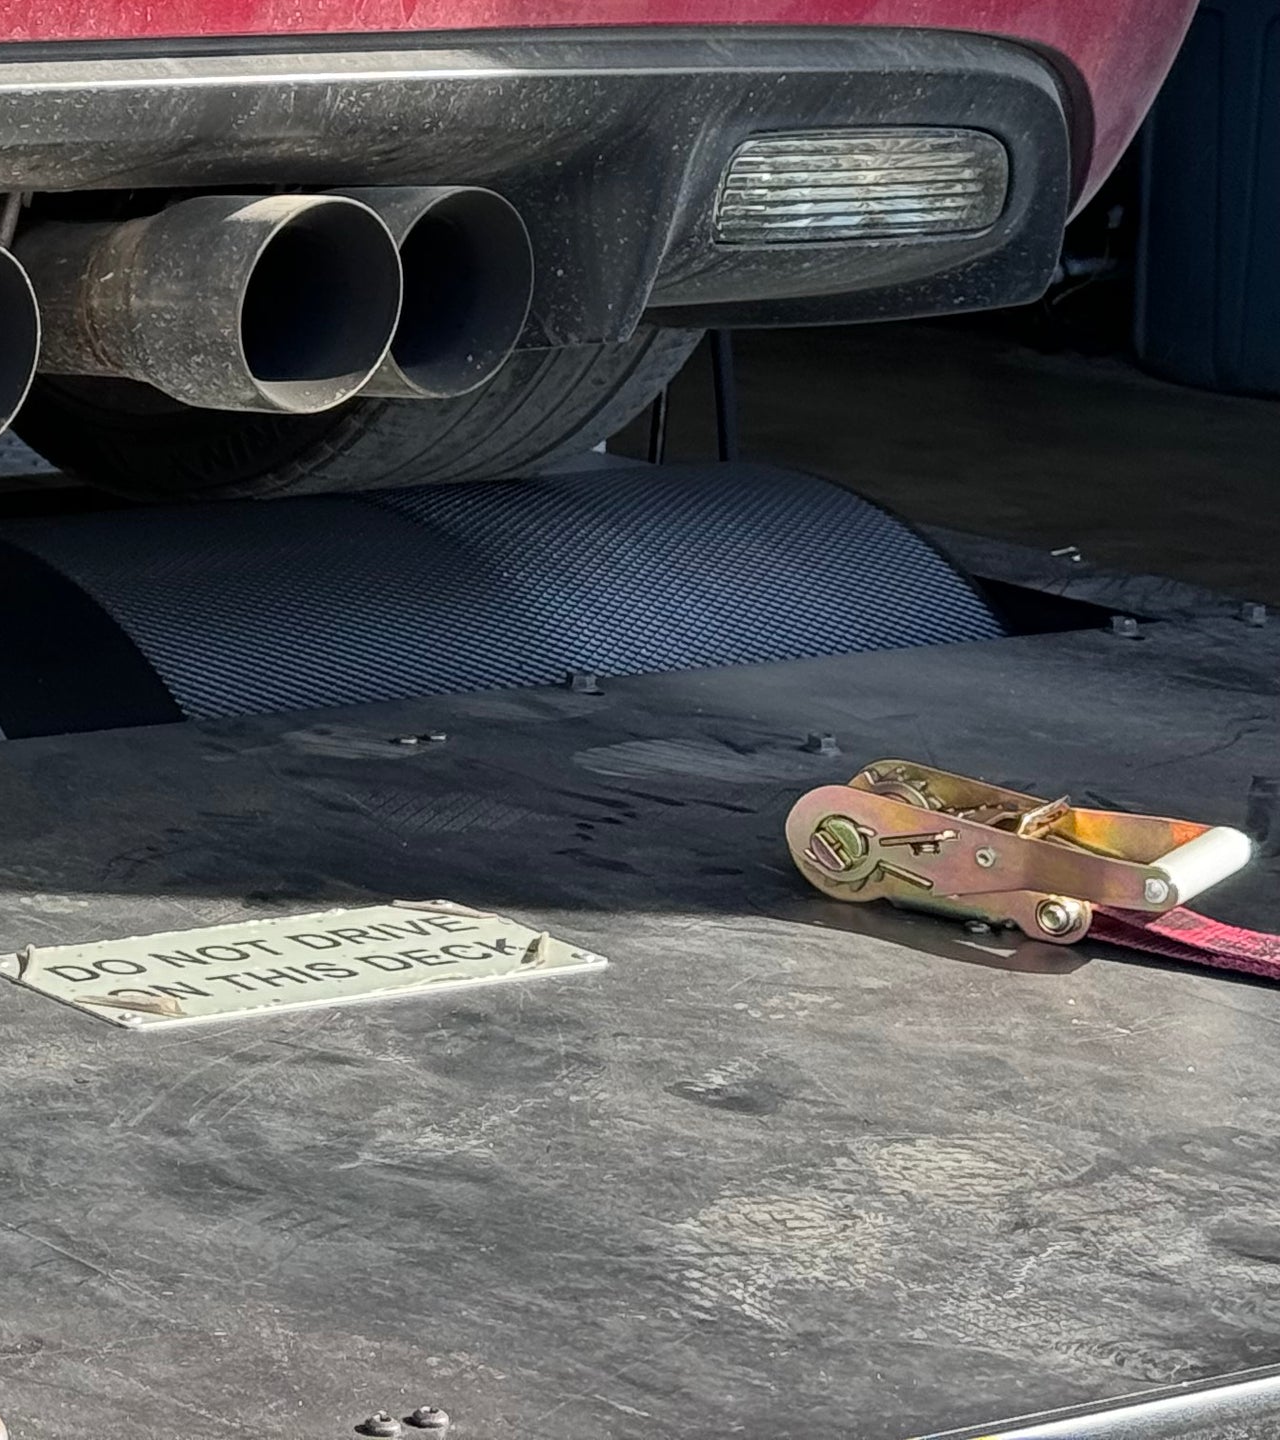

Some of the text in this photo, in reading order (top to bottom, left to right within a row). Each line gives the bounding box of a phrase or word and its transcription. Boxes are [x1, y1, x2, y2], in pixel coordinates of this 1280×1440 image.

[42, 915, 479, 982] DO NOT DRIVE
[204, 962, 359, 991] THIS
[354, 937, 520, 972] DECK
